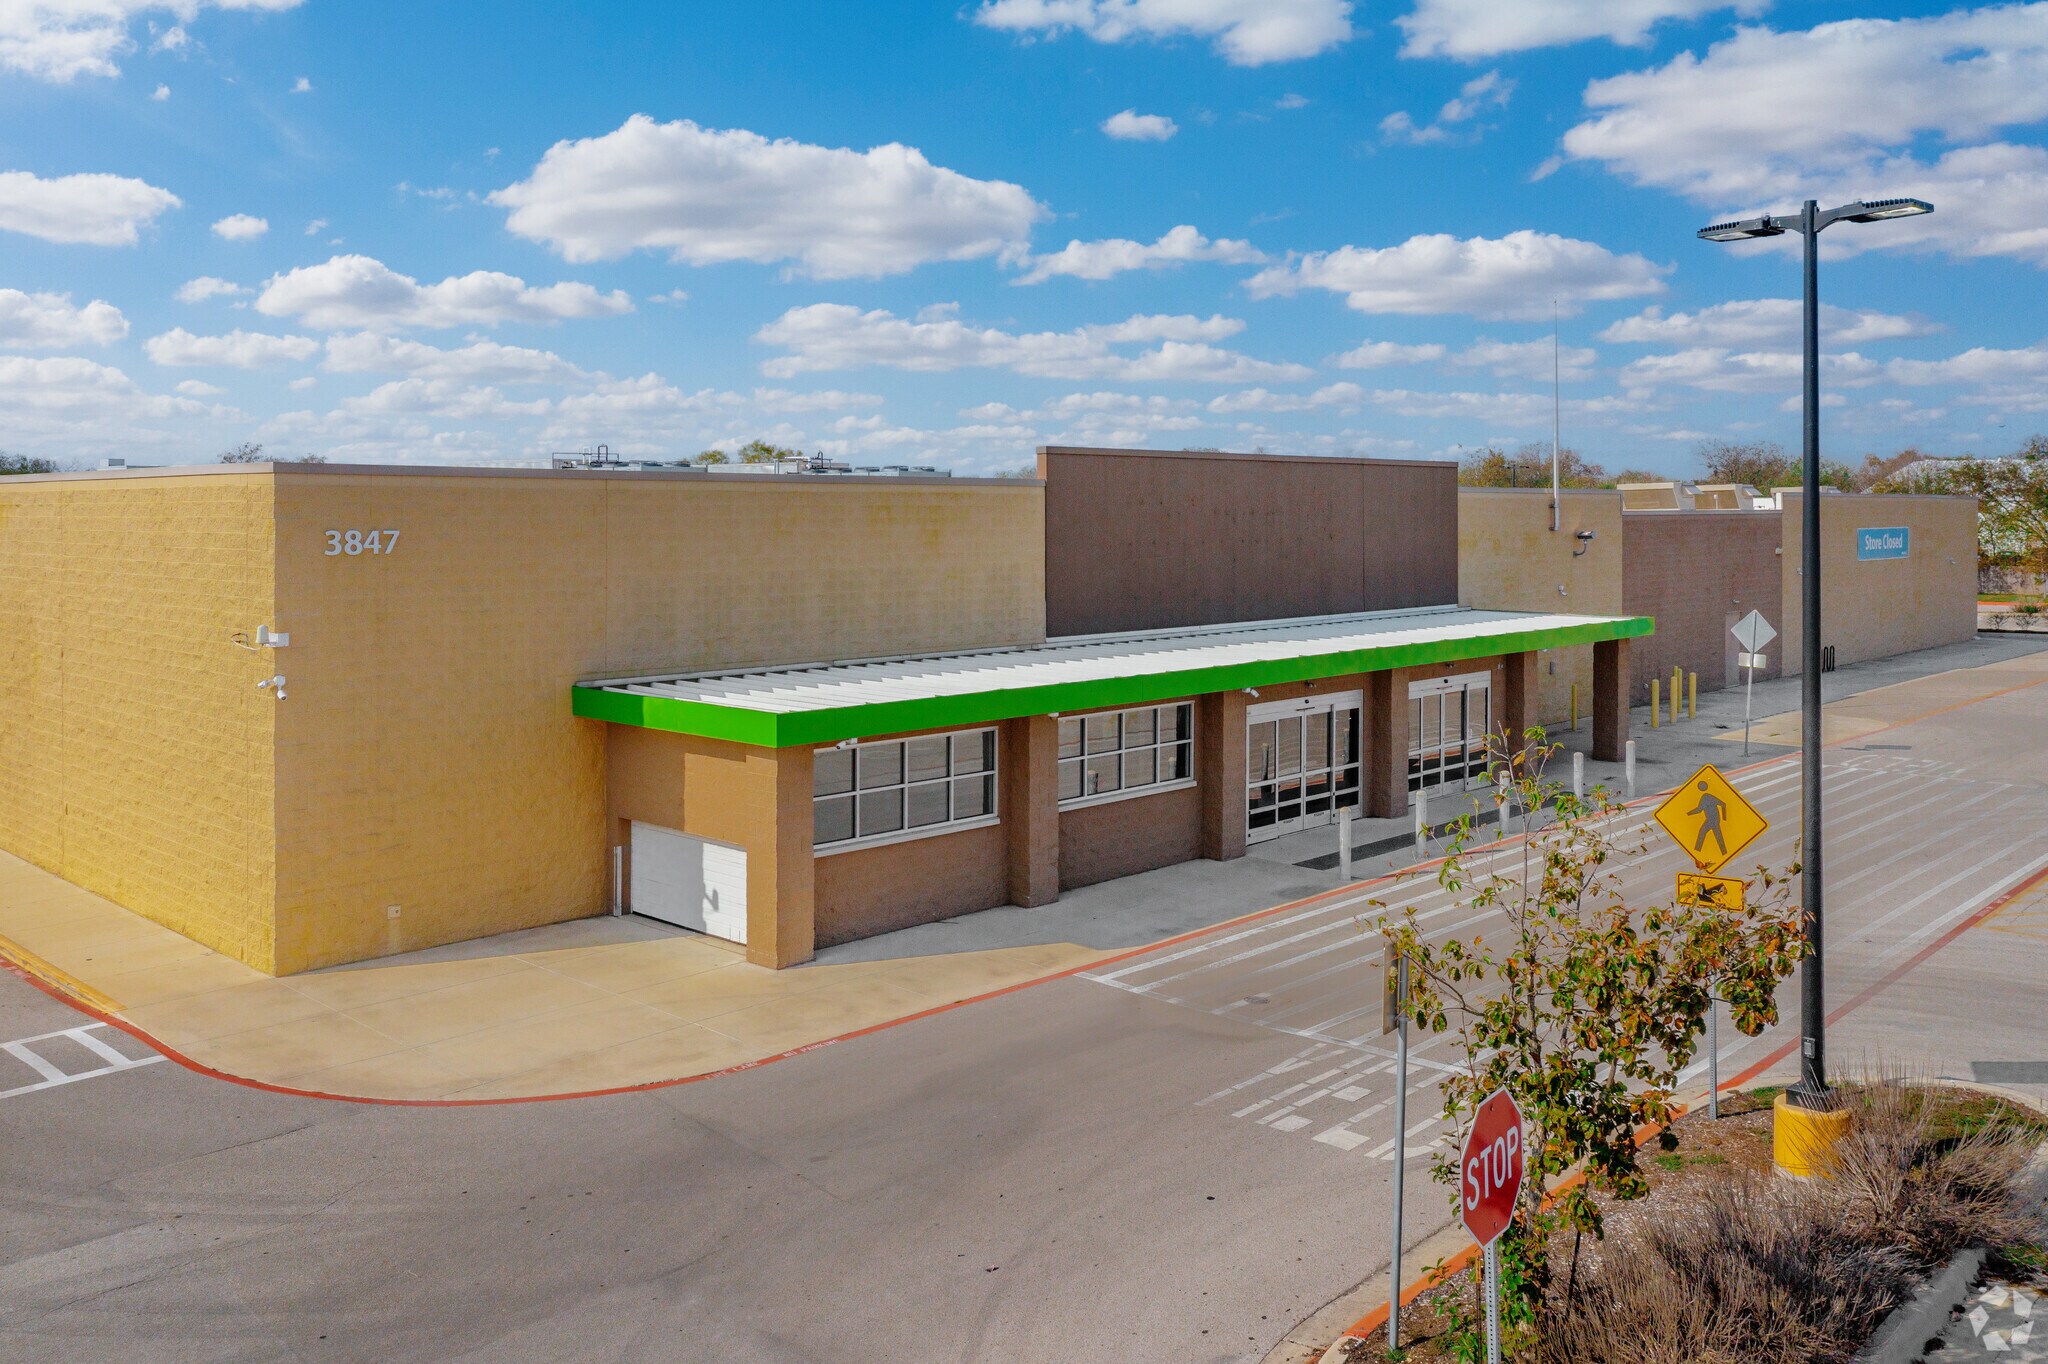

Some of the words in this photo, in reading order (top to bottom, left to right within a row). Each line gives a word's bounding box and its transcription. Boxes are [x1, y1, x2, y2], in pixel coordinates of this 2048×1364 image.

[324, 529, 400, 556] 3847
[1865, 534, 1882, 550] Store
[1882, 533, 1903, 549] Closed
[1466, 1125, 1519, 1211] STOP
